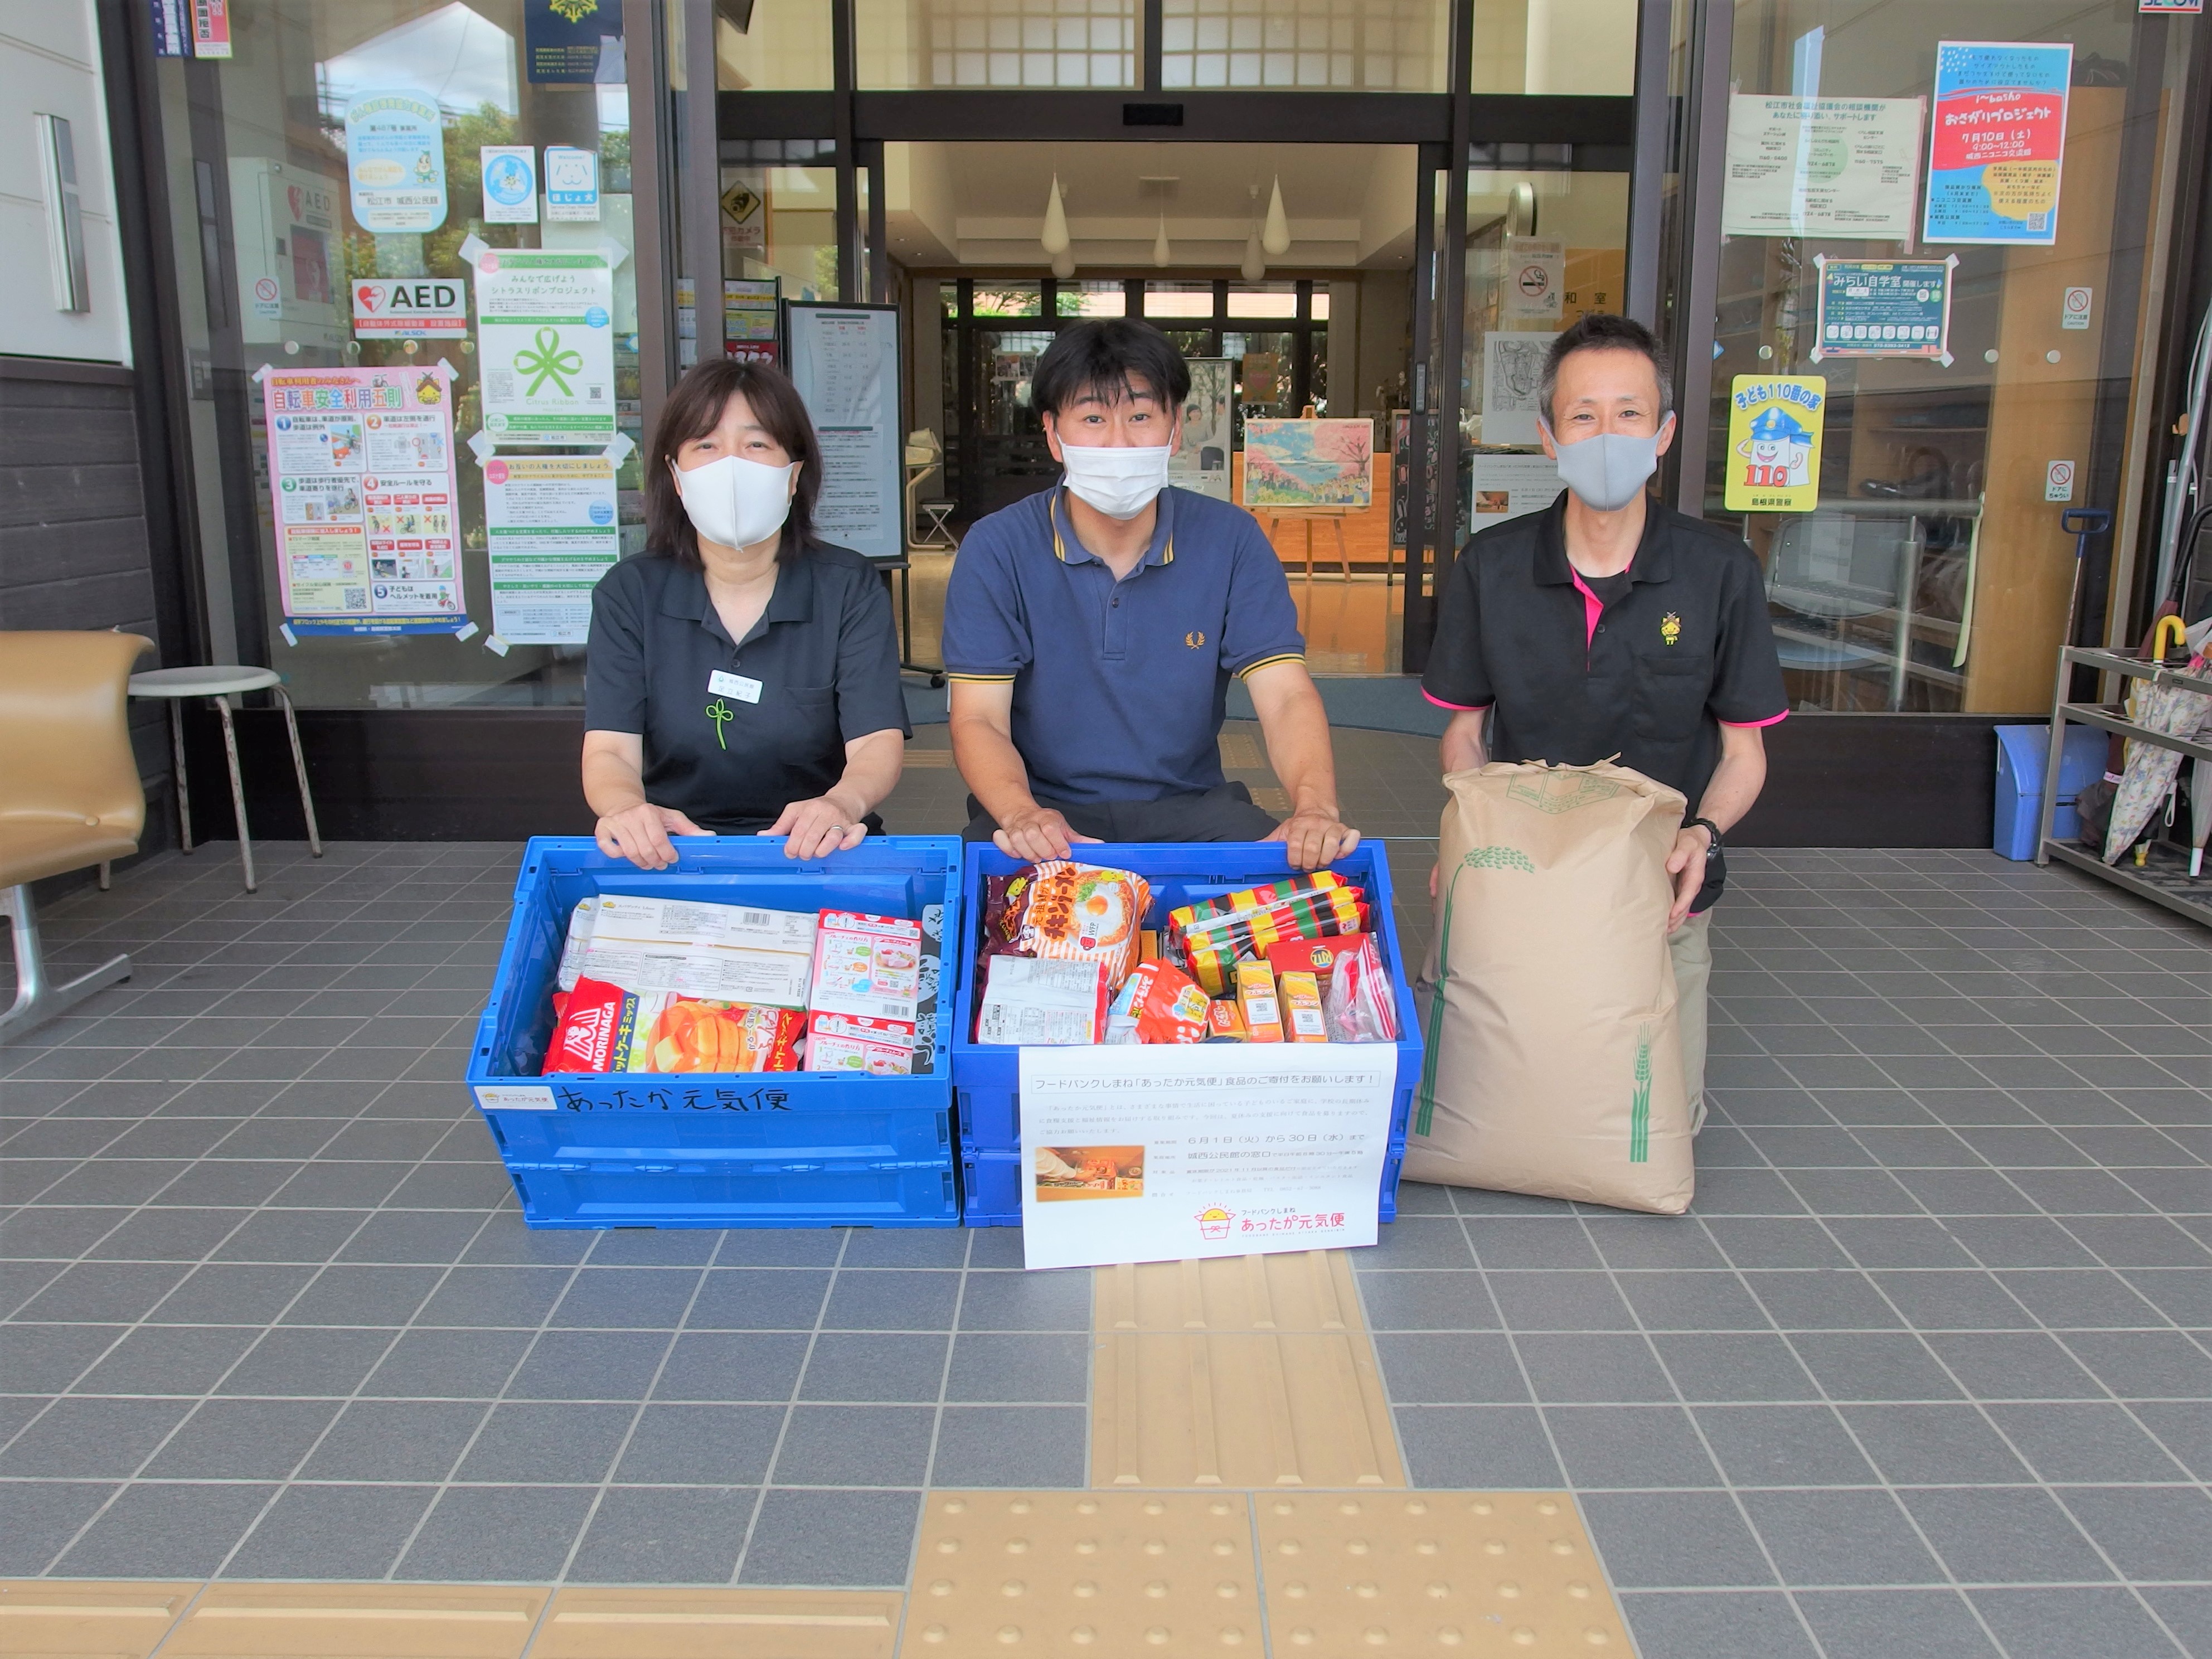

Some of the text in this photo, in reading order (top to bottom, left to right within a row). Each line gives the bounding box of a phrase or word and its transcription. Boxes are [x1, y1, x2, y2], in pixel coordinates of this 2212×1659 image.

[1945, 106, 2052, 126] おさがりプロジェクト
[552, 193, 593, 202] ほじょ犬
[511, 274, 575, 283] みんなで広げよう
[1833, 275, 1902, 288] みらい自学室
[390, 285, 456, 308] AED
[491, 286, 596, 295] シトラスリボンプロジェクト
[271, 376, 361, 386] 自転車利用者のみなさんへ
[273, 386, 402, 410] 自転車安全利用五則
[1735, 383, 1822, 409] 子ども110番の家
[1744, 464, 1789, 487] 110
[1751, 498, 1792, 507] 島根県警察
[1044, 867, 1077, 940] チキンラーメン
[828, 933, 869, 943] フルーチェの作り方
[1311, 950, 1333, 964] RITZ
[591, 1002, 616, 1072] MORINAGA
[613, 997, 636, 1073] ットケーキミックス
[558, 1086, 793, 1112] あったか元気便
[1241, 1207, 1296, 1216] フードバンクしまね
